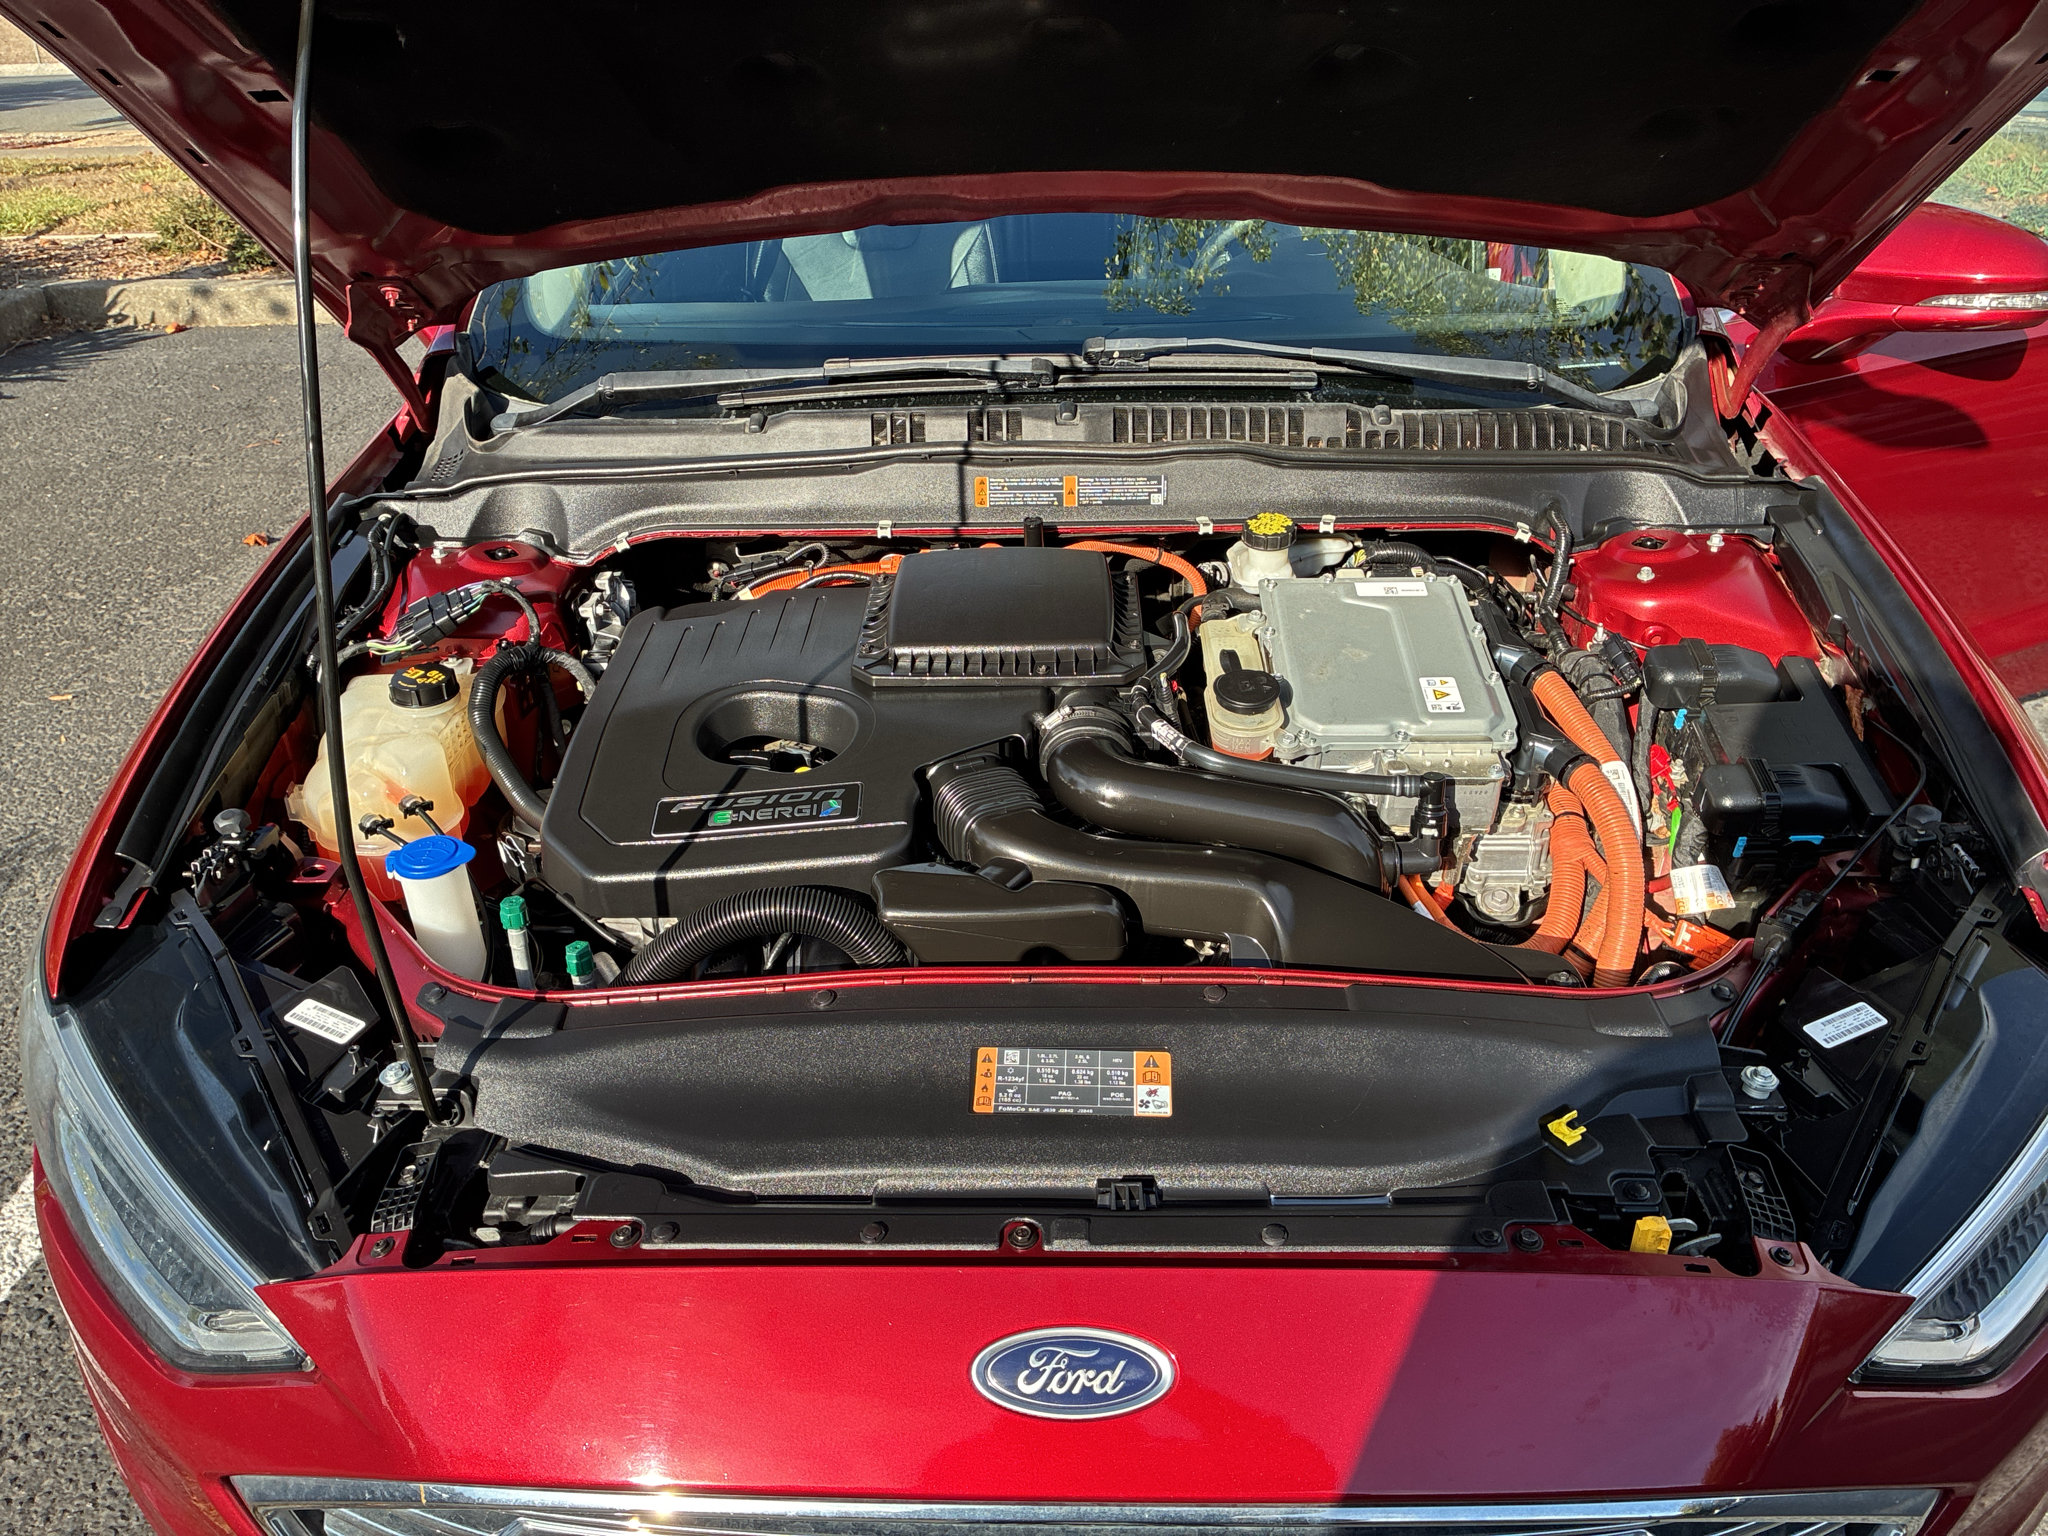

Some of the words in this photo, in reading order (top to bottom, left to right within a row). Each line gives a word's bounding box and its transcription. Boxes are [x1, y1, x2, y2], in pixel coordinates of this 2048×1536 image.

[670, 788, 846, 814] FUSION
[997, 1075, 1025, 1083] R-1234yf
[1017, 1345, 1128, 1395] Ford
